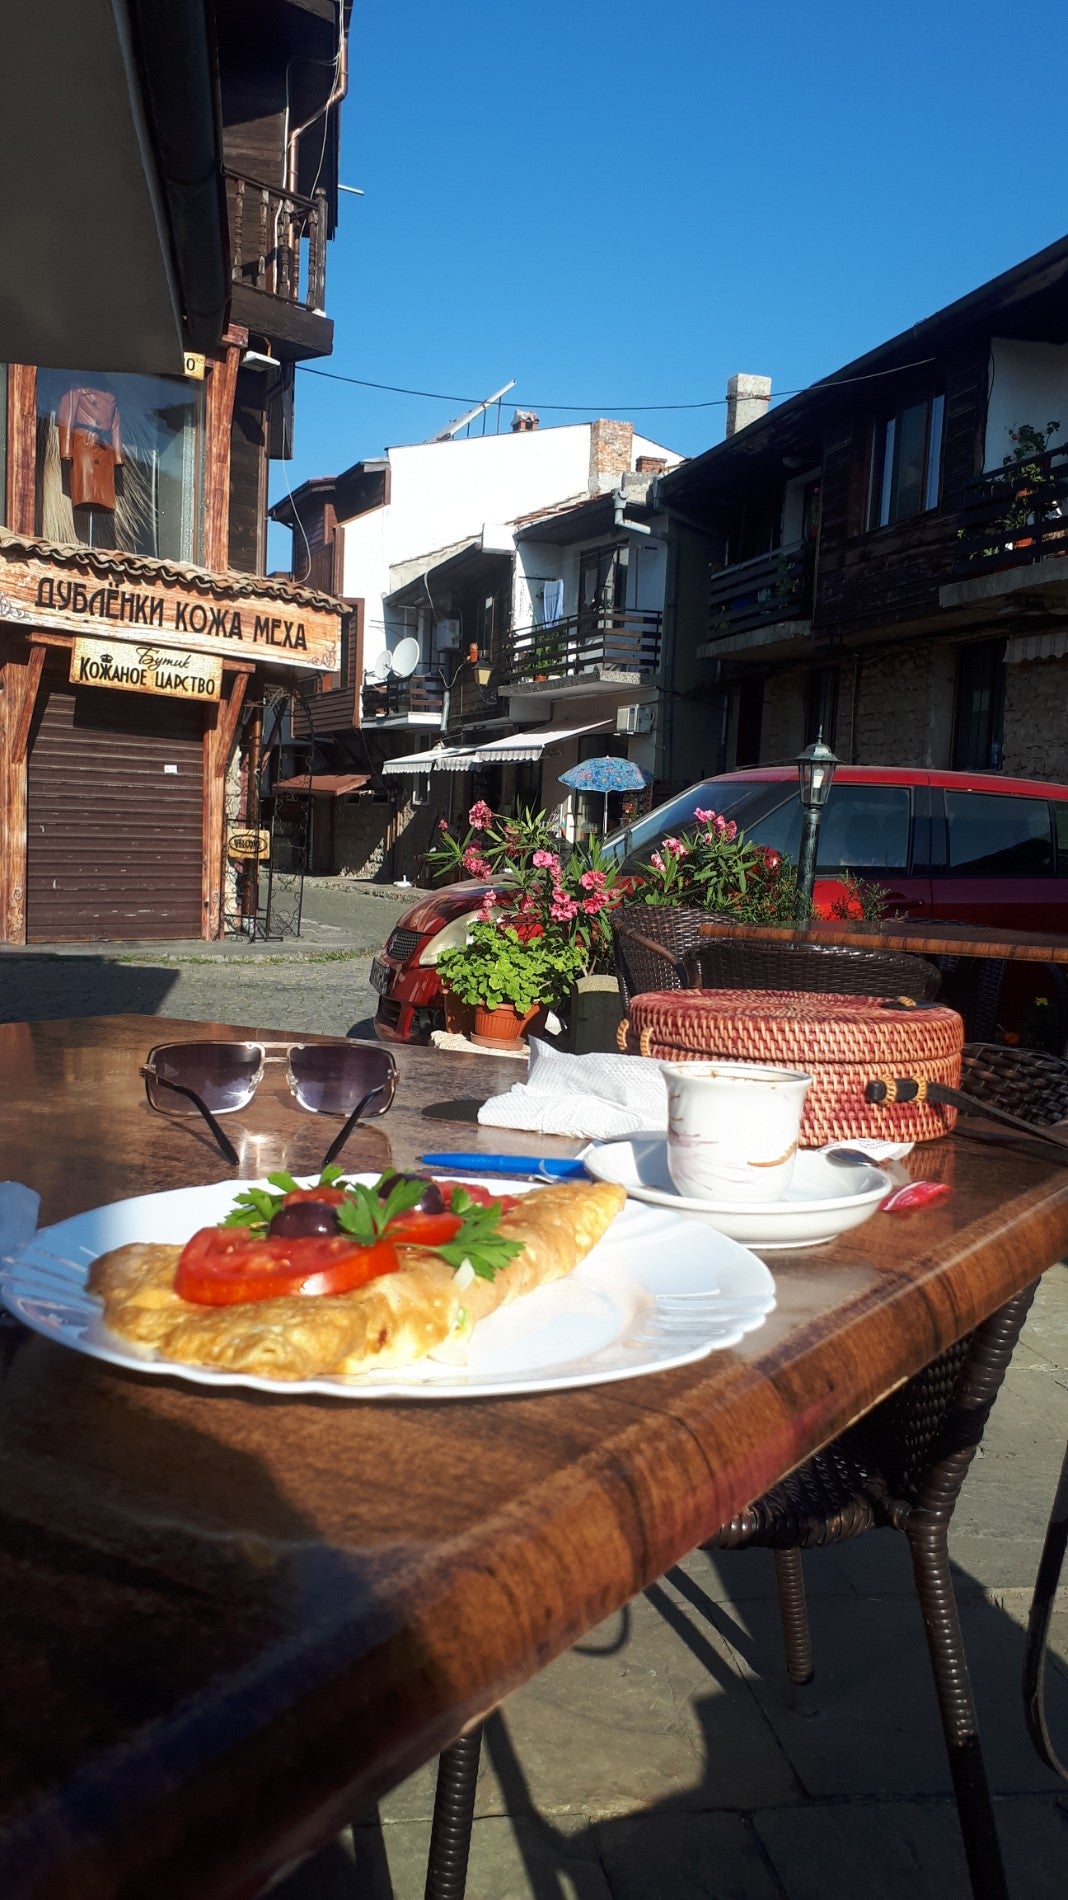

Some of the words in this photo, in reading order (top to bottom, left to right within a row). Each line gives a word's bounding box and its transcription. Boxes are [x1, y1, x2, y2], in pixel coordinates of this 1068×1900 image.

[34, 577, 164, 627] ДУБЛЁНКИ
[175, 601, 243, 640] КОЖА
[253, 615, 307, 650] МЕХА
[136, 646, 191, 671] Бутик
[155, 670, 215, 695] ЦАРСТВО
